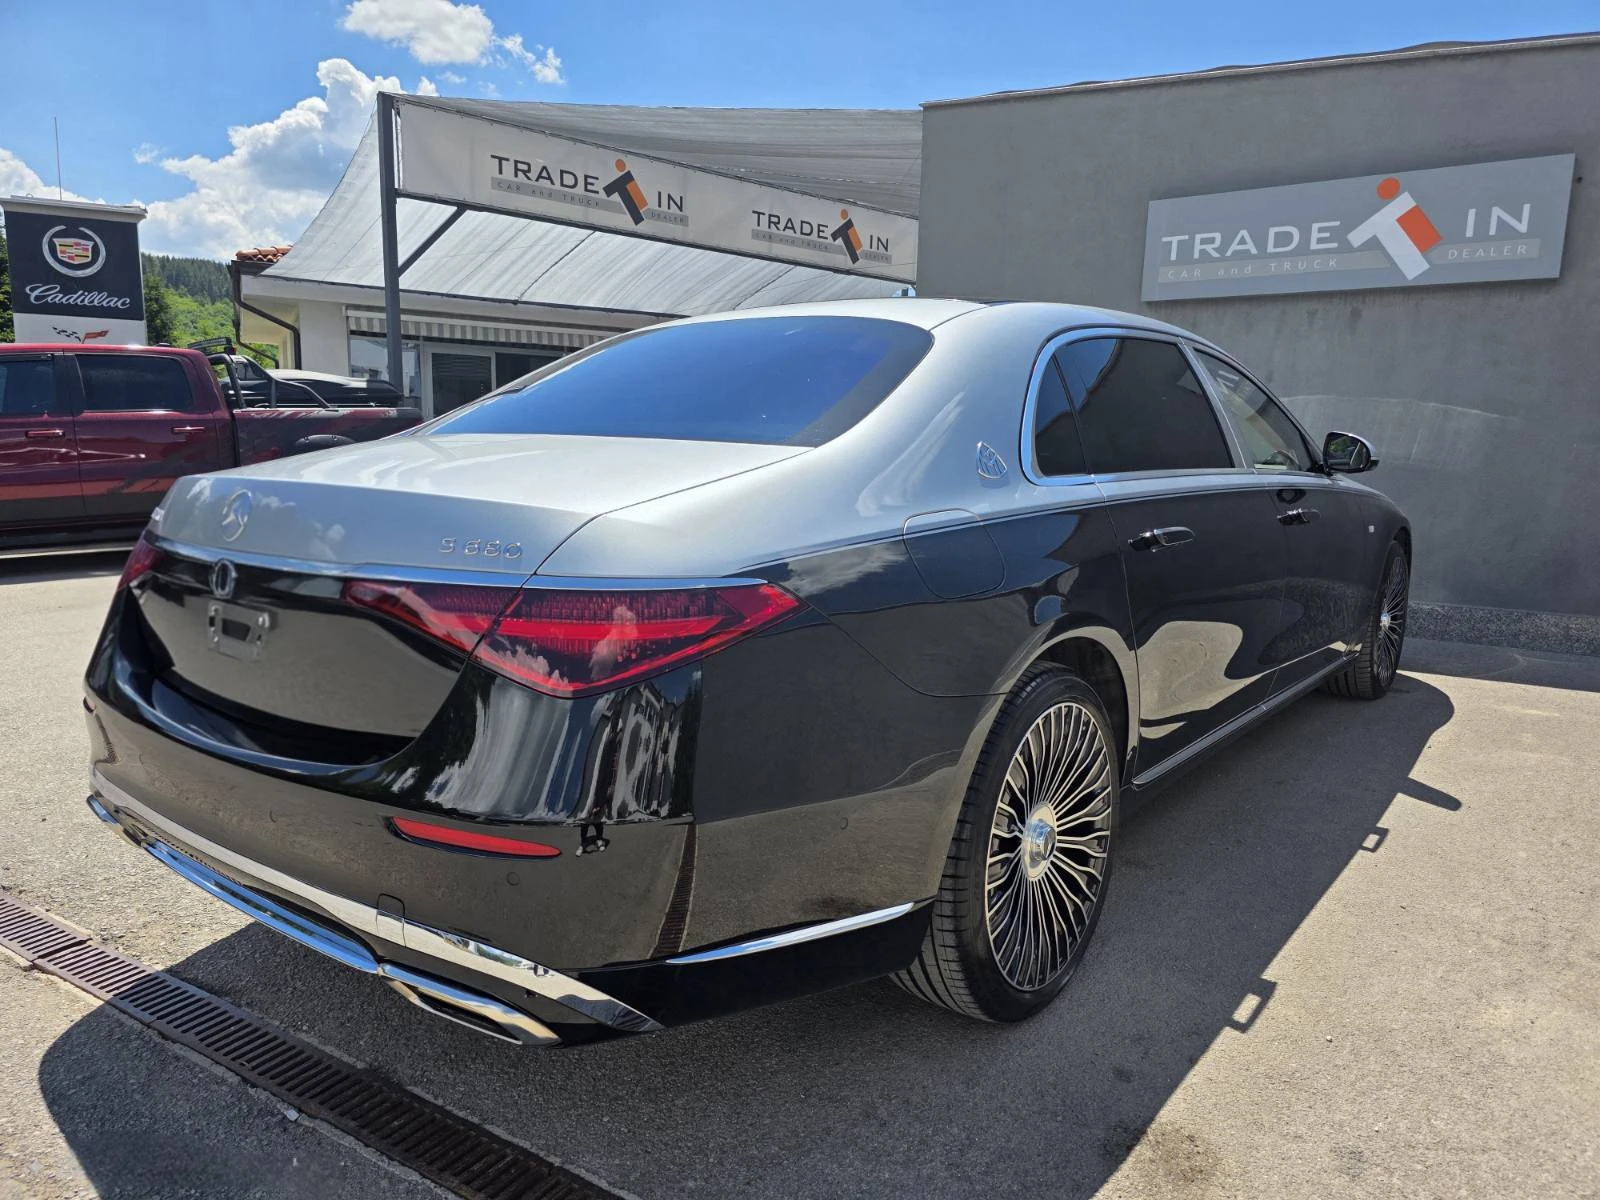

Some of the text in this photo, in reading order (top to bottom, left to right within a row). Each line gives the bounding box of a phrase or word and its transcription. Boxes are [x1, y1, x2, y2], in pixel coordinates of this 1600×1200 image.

[490, 154, 684, 213] TRADE IN
[751, 209, 889, 253] TRADE IN
[1161, 203, 1531, 261] TRADE IN
[1447, 244, 1529, 260] DEALER
[1167, 258, 1338, 280] CAR and TRUCK
[25, 283, 131, 309] Cadillac
[439, 537, 457, 553] S
